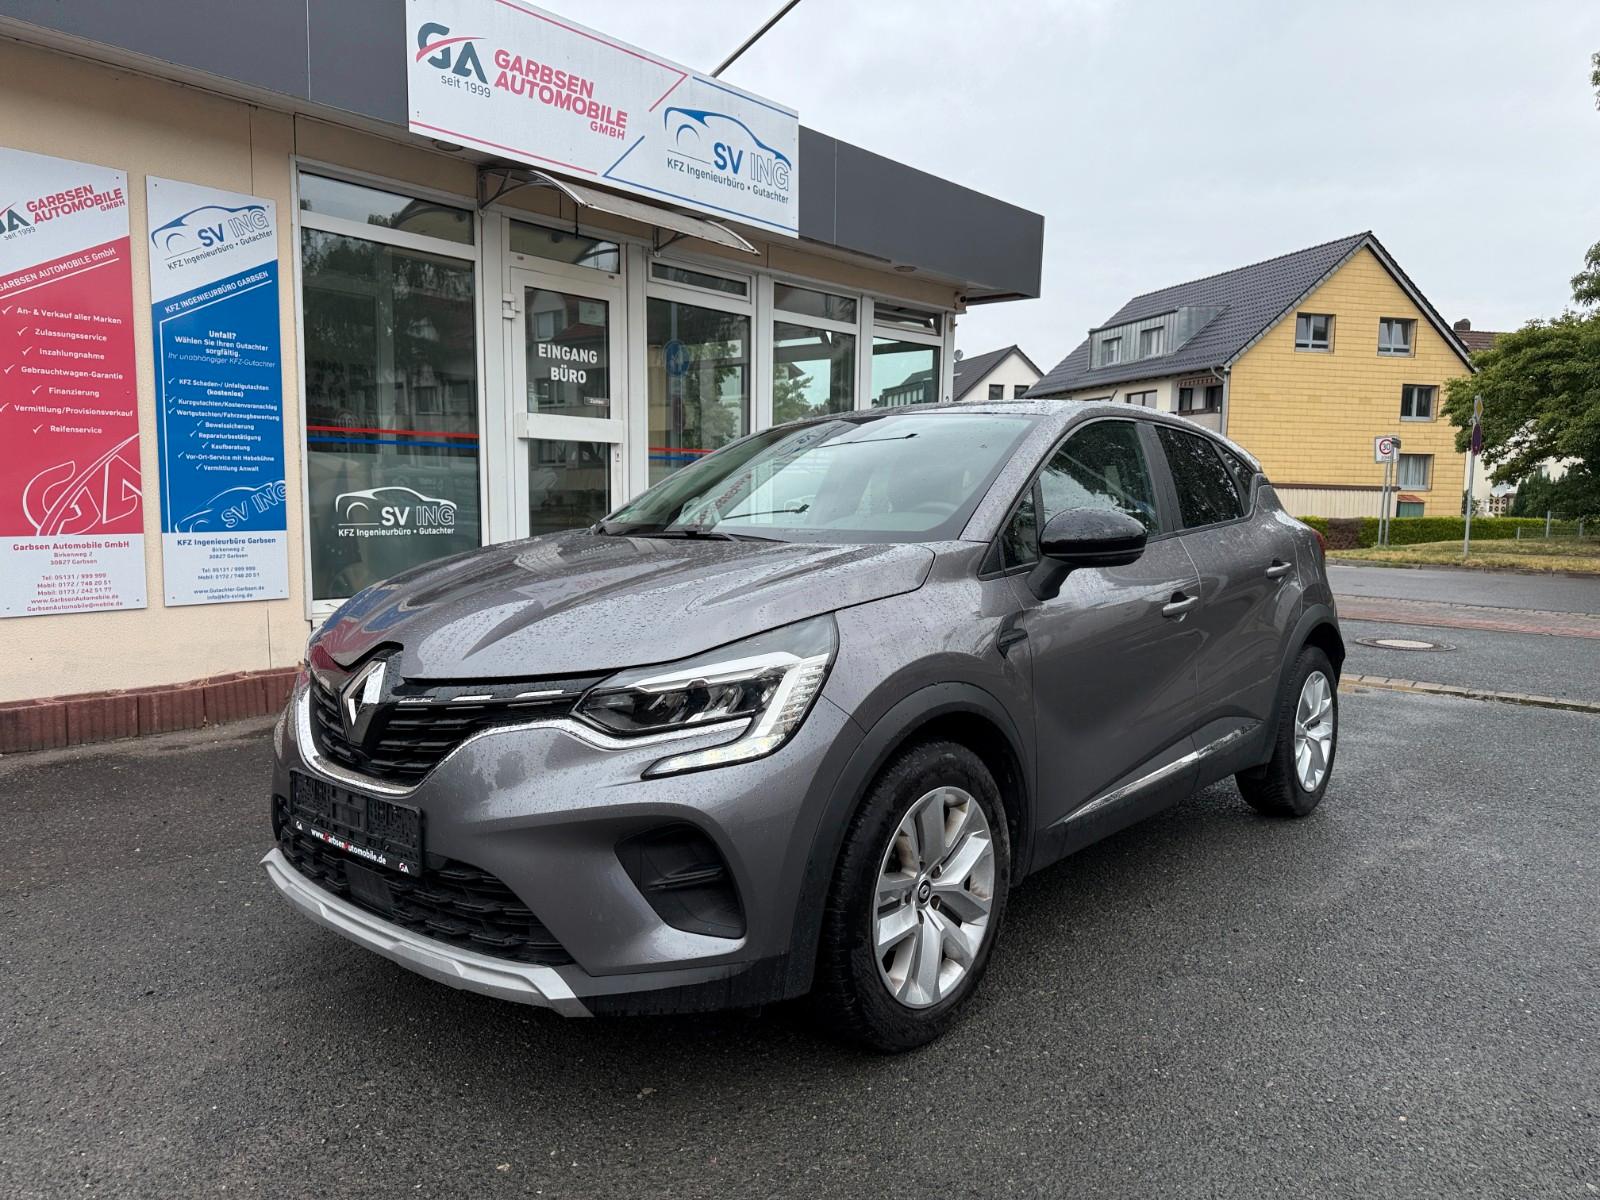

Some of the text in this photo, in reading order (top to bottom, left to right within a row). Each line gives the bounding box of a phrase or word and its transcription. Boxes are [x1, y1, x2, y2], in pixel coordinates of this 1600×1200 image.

[494, 48, 594, 99] GARBSEN
[440, 74, 492, 98] seit 1999
[494, 70, 628, 129] AUTOMOBILE
[590, 121, 626, 140] GMBH
[713, 142, 790, 191] SV ING
[666, 157, 788, 204] KFZ Ingenieurbüro Gutachter
[26, 184, 94, 212] GARBSEN
[34, 188, 124, 224] AUTOMOBILE
[100, 200, 126, 212] GMBH
[0, 208, 30, 235] A
[198, 210, 269, 248] SV ING
[4, 226, 36, 240] seit 1999
[168, 230, 272, 270] KFZ Ingenieurbüro Gutachter
[39, 256, 91, 279] AUTOMOBILE
[92, 248, 116, 262] GmbH
[164, 270, 268, 314] KFZ INGENIEURBÜRO GARBSEN
[41, 310, 72, 319] Verkauf
[94, 316, 122, 324] Marken
[35, 328, 107, 341] Zulassungsservice
[209, 330, 236, 340] Unfall?
[175, 336, 202, 346] Wählen
[236, 342, 268, 351] Gutachter
[40, 348, 104, 360] Inzahlungnahme
[206, 348, 240, 357] sorgfältig.
[538, 344, 598, 364] EINGANG
[180, 353, 228, 364] unabhängiger
[229, 358, 276, 368] KFZ-Gutachter
[21, 366, 123, 380] Gebrauchtwagen-Garantie
[550, 364, 586, 383] BÜRO
[48, 388, 100, 398] Finanzierung
[207, 390, 244, 398] (kostenlos)
[14, 404, 133, 416] Vermittlung/Provisionsverkauf
[50, 426, 102, 434] Reifenservice
[211, 444, 250, 452] Kaufberatung
[1382, 443, 1390, 451] 30
[221, 500, 248, 528] SV
[381, 506, 454, 526] SV ING
[356, 528, 411, 538] Ingenieurbüro
[194, 538, 246, 546] Ingenieurbüro
